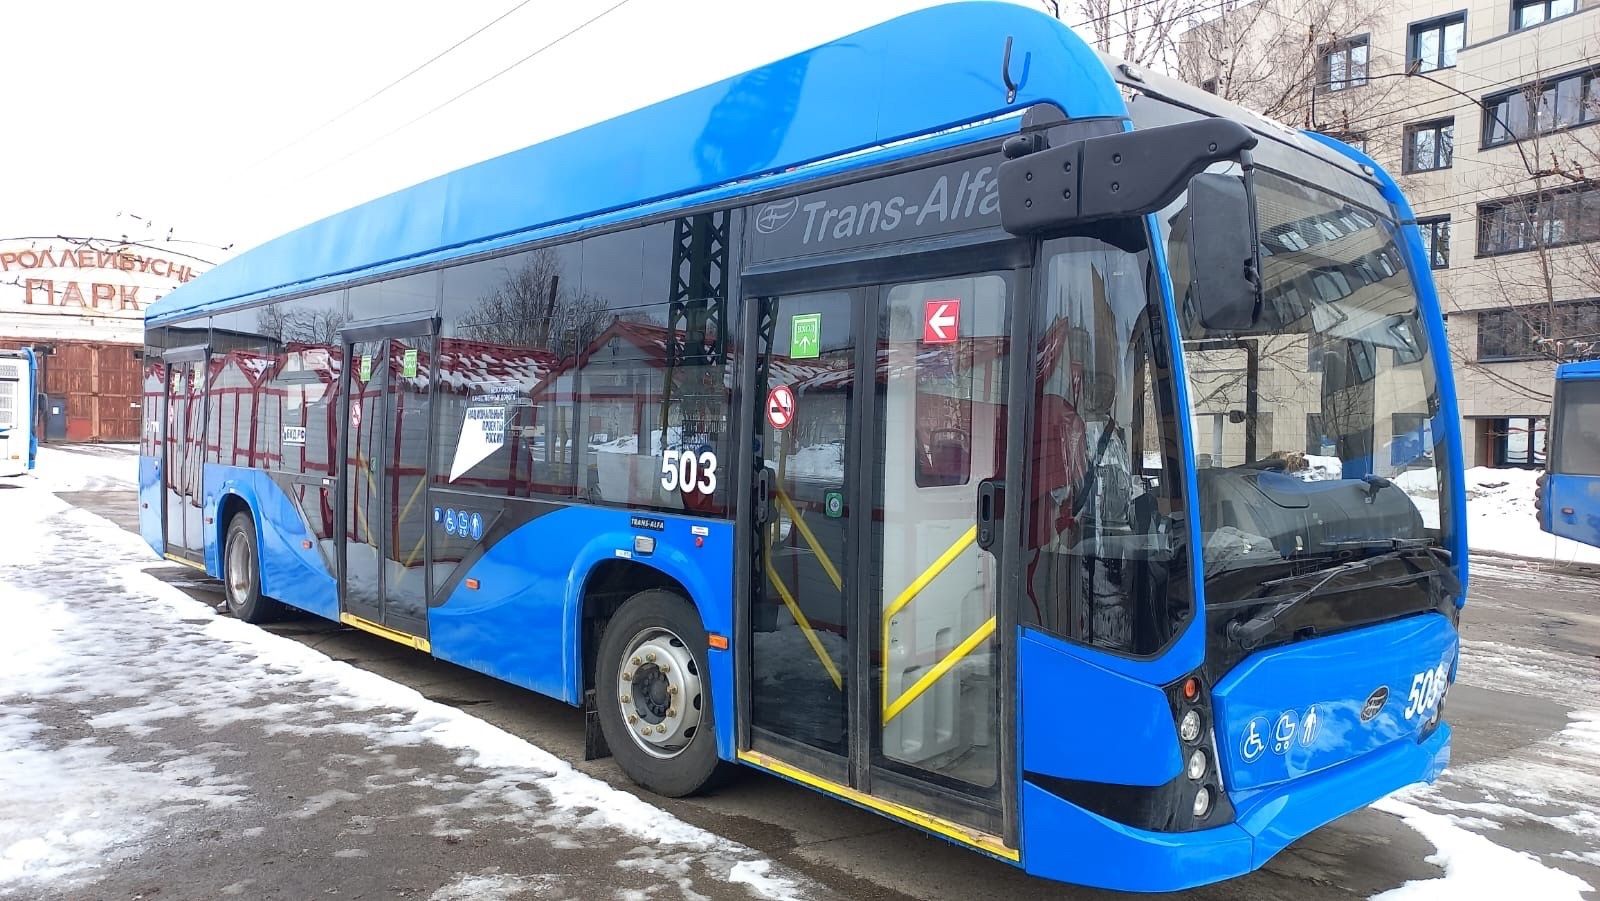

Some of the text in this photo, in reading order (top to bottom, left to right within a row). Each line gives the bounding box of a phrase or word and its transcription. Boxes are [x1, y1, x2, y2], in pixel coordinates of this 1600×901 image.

[802, 166, 1001, 244] Trans-Alfa
[25, 278, 140, 310] ПАРК
[482, 420, 504, 431] ПРОЕКТЫ
[485, 432, 504, 444] РОССИИ
[661, 450, 717, 495] 503
[631, 517, 664, 529] TRANS-ALFA
